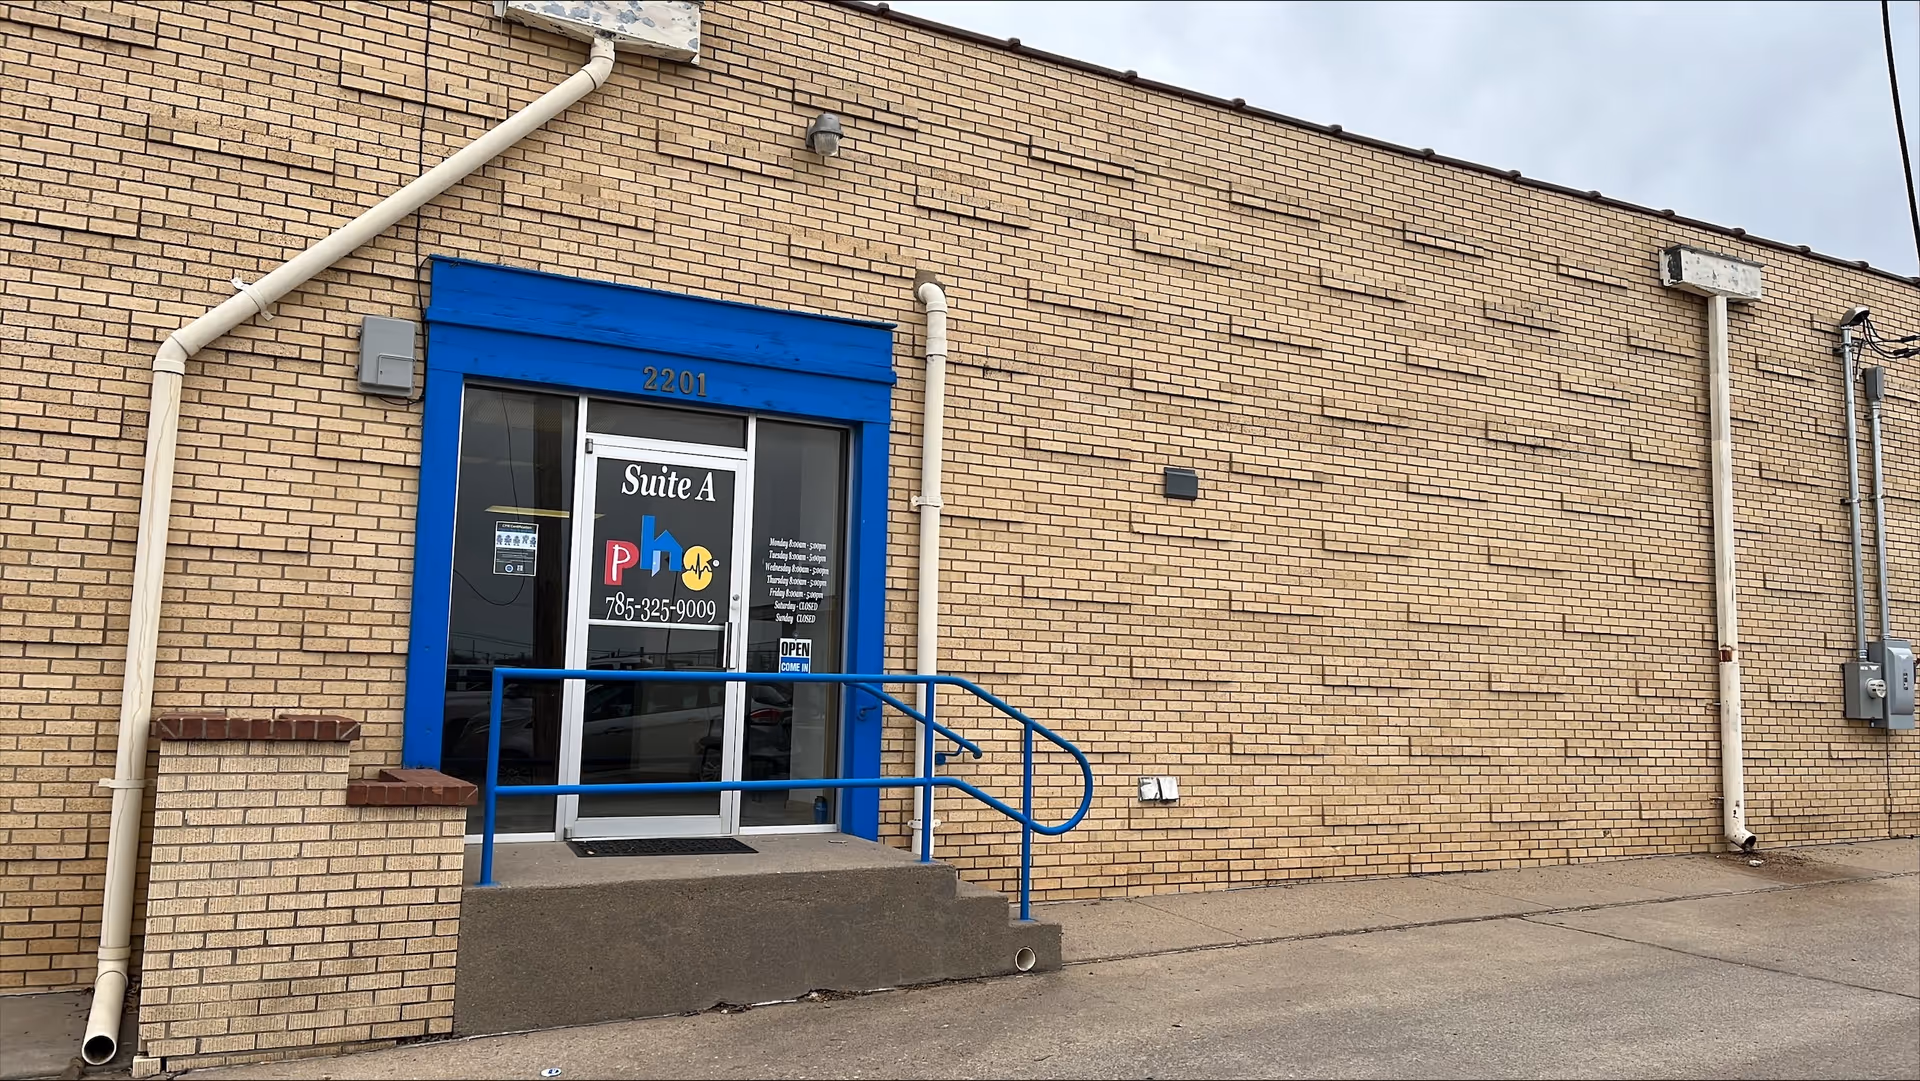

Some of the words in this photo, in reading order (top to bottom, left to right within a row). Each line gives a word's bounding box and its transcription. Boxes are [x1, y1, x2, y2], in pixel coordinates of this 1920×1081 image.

[643, 366, 706, 397] 2201
[621, 464, 692, 500] Suite
[695, 472, 716, 502] A
[769, 538, 788, 549] Monday
[769, 550, 788, 561] Tuesday
[765, 563, 791, 574] Wednesday
[767, 575, 788, 586] Thursday
[769, 588, 785, 598] Friday
[605, 591, 717, 623] 785-325-9009
[774, 601, 796, 611] Saturday
[799, 602, 818, 610] CLOSED
[775, 613, 793, 624] Sunday
[797, 614, 815, 623] CLOSED
[781, 641, 810, 657] OPEN
[781, 662, 800, 672] COME
[802, 663, 809, 672] IN
